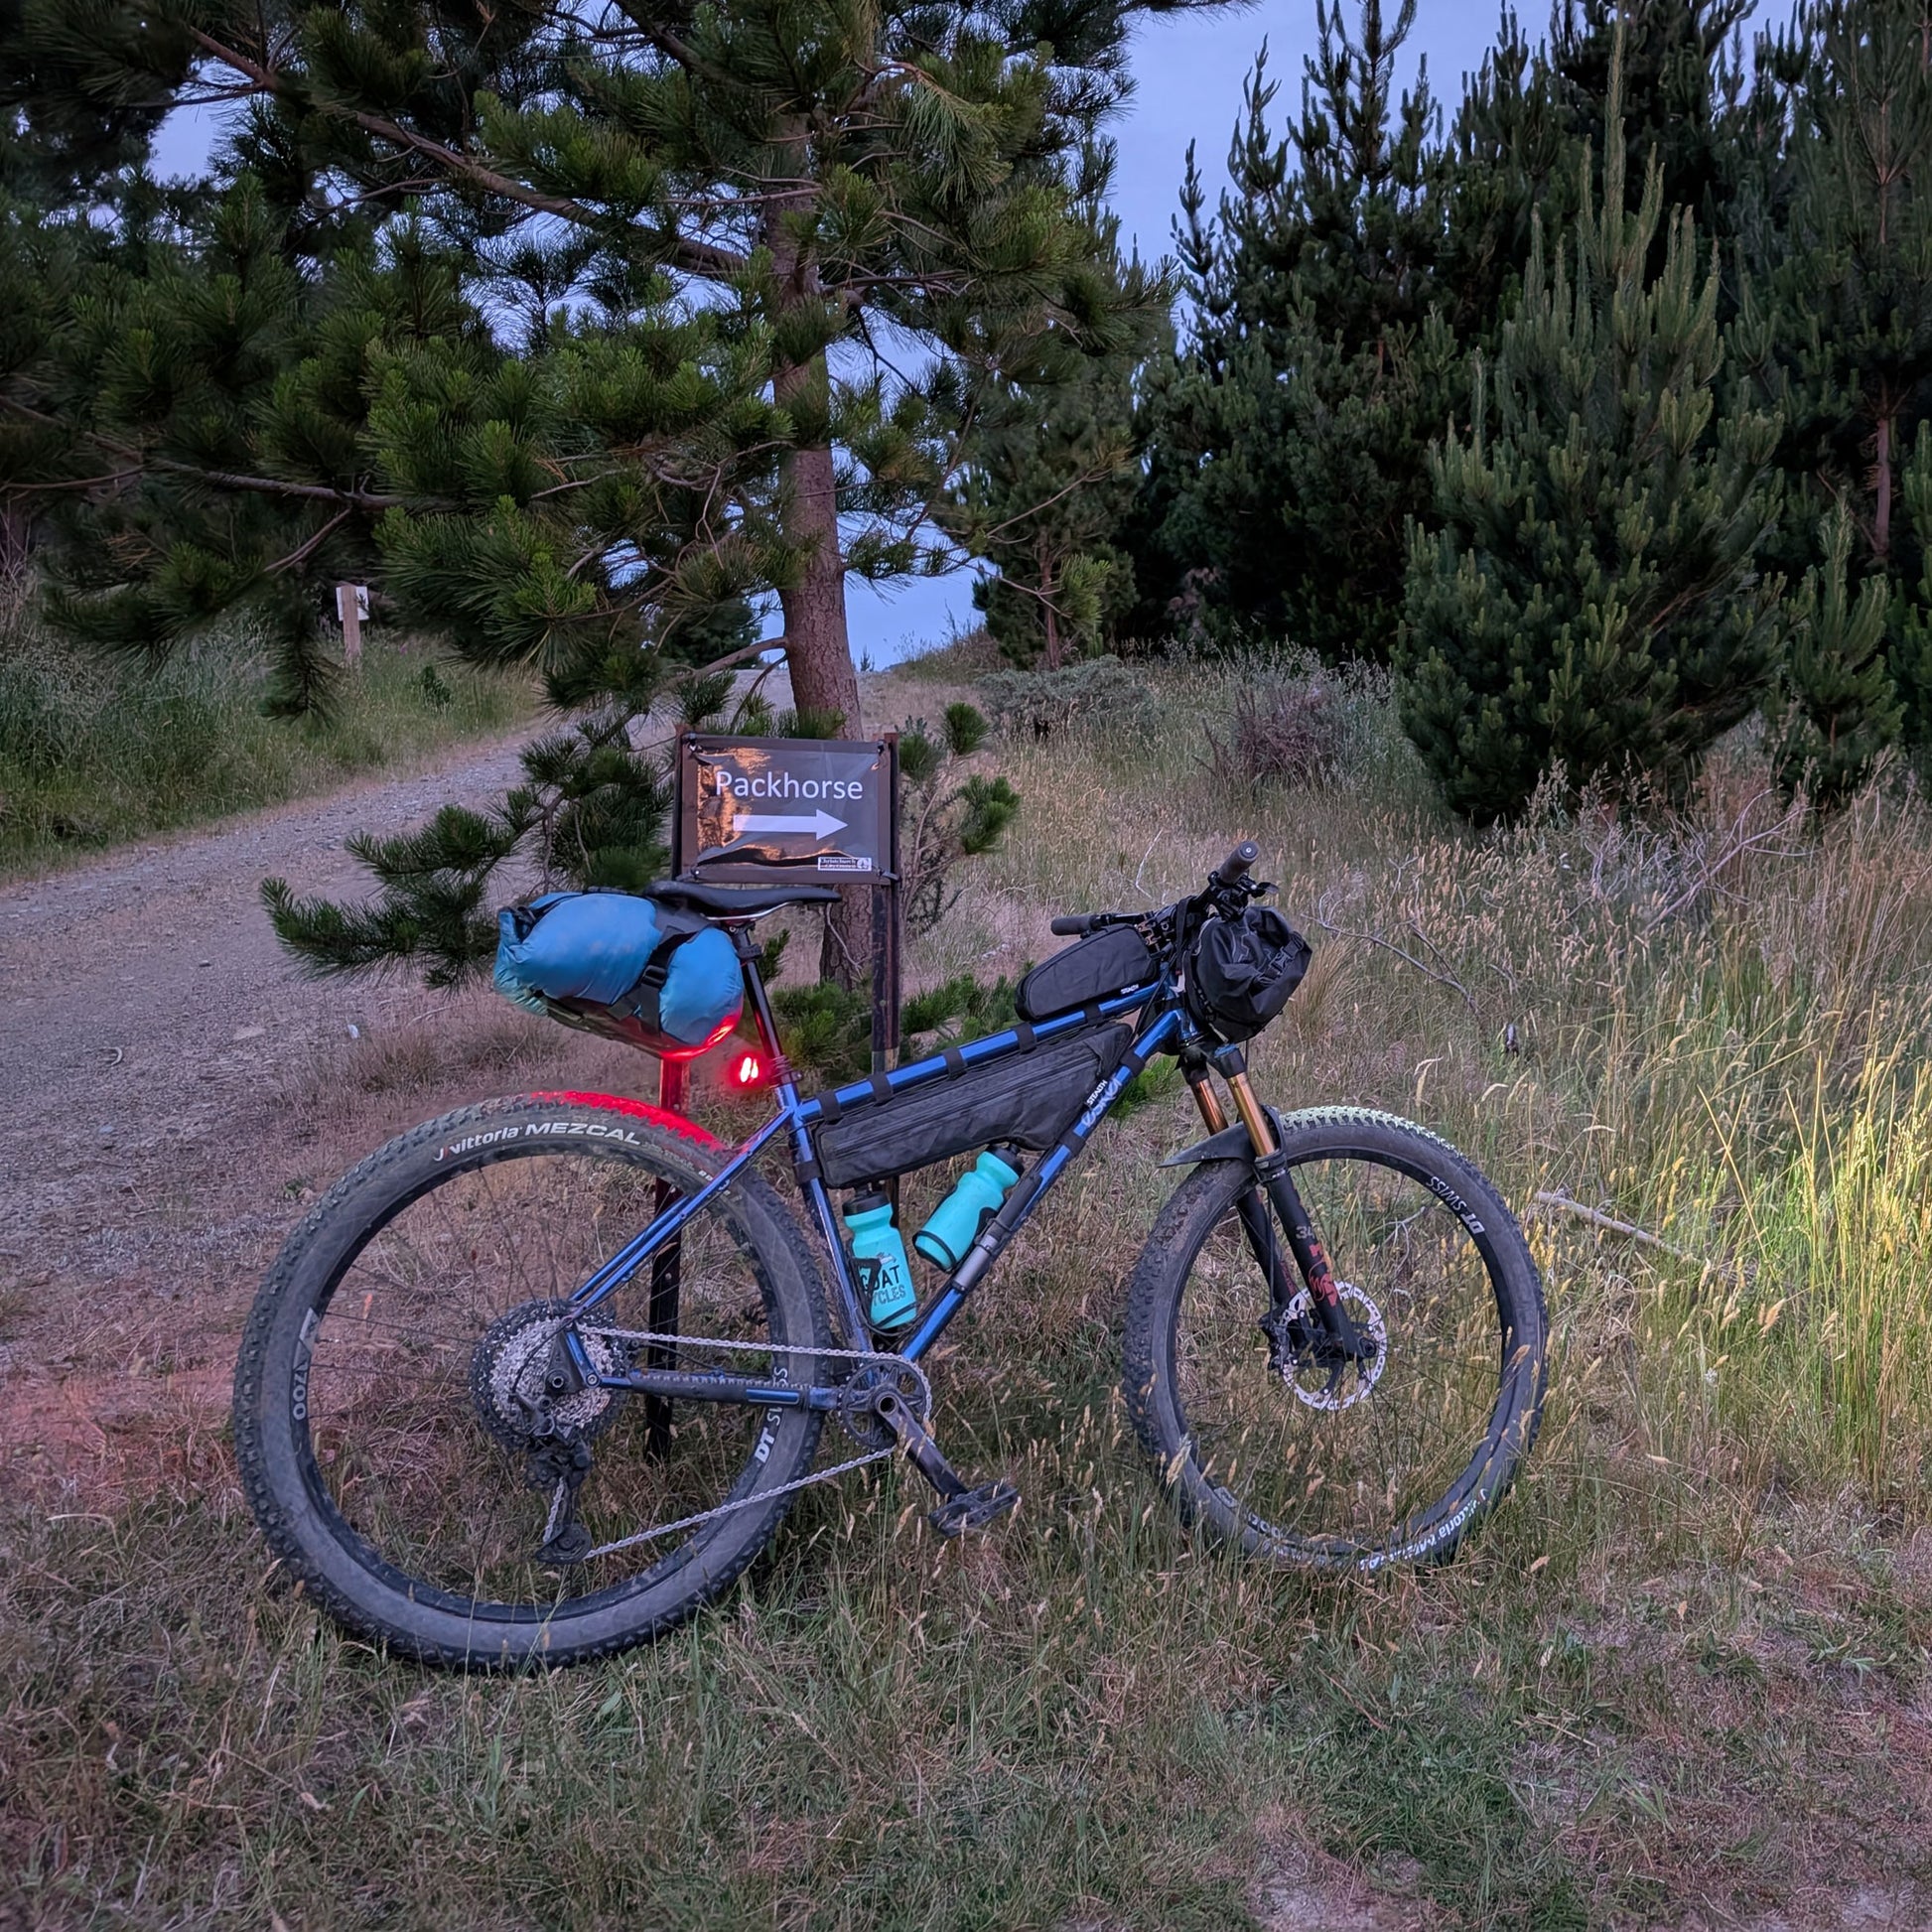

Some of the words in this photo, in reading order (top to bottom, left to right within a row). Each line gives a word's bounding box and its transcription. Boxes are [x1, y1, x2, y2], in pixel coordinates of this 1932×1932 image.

[716, 770, 864, 800] Packhorse
[449, 1126, 519, 1156] vittoria
[524, 1122, 641, 1147] MEZCAL
[1426, 1175, 1467, 1210] SWISS
[1460, 1212, 1485, 1234] DT
[754, 1426, 775, 1463] DT
